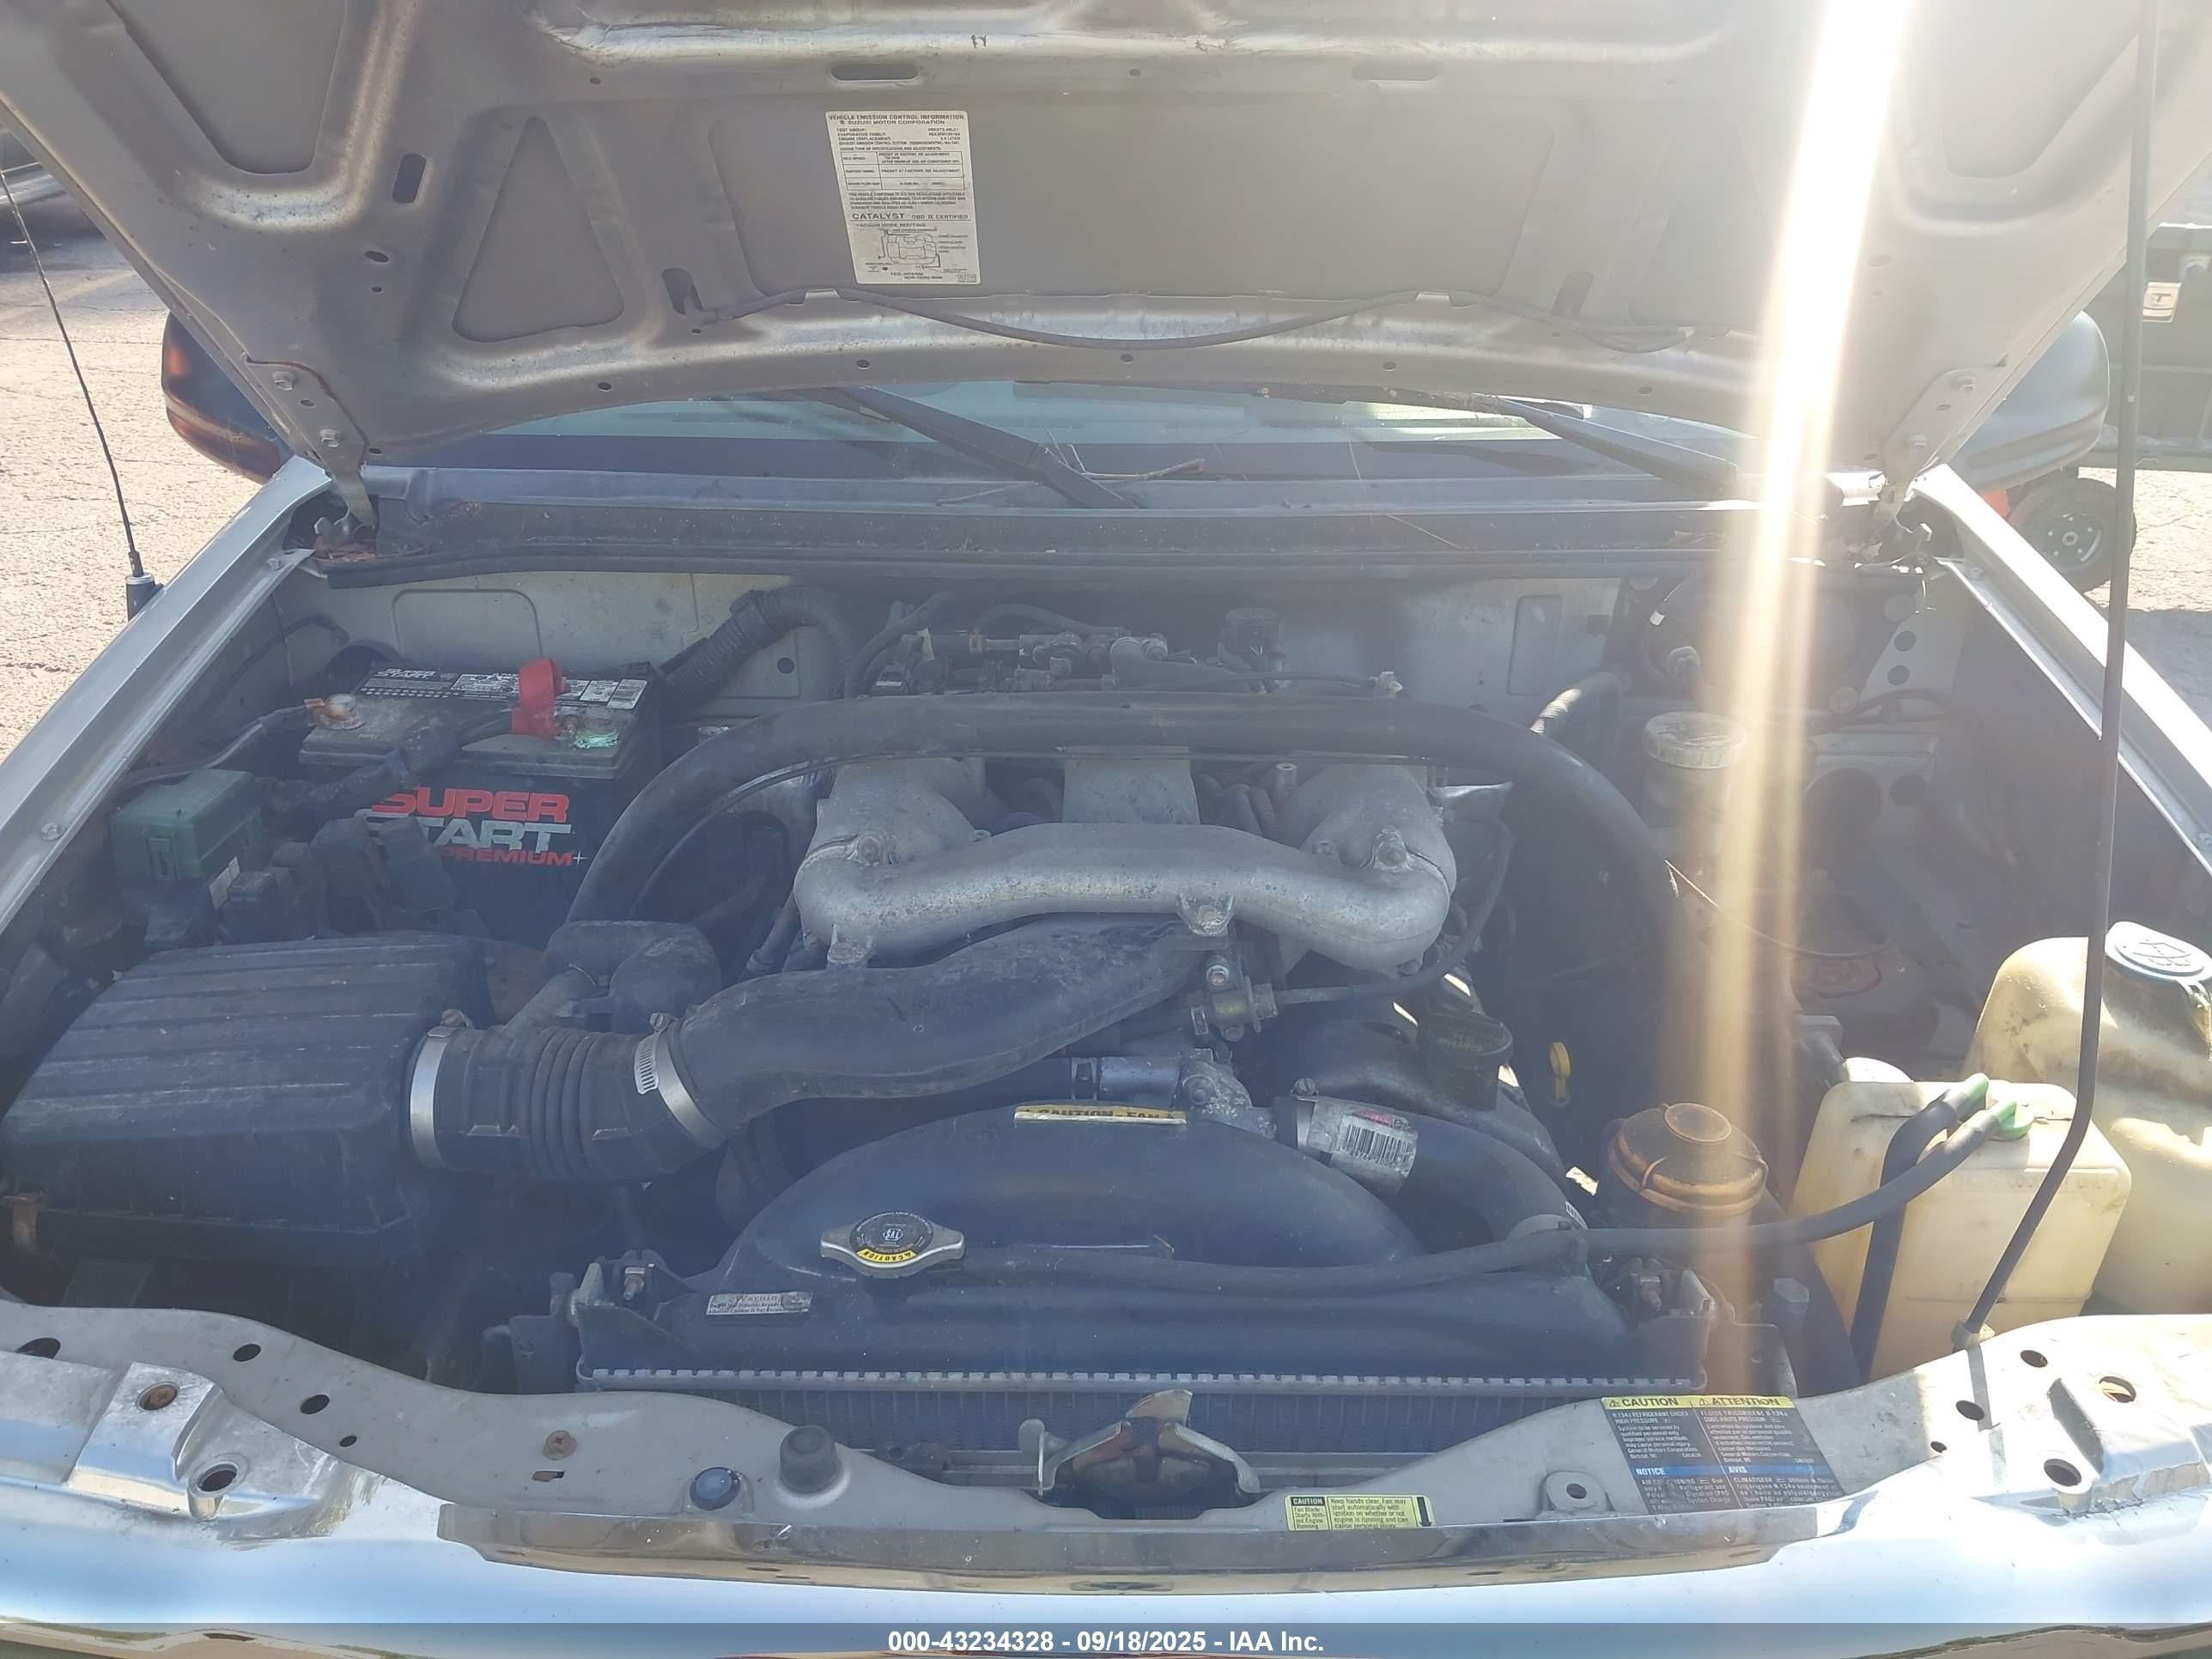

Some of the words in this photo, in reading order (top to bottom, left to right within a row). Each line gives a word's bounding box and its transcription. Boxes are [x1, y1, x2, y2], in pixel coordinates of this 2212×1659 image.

[371, 786, 570, 823] SUPER
[862, 1251, 904, 1261] CAUTION
[1622, 1398, 1680, 1407] CAUTION
[1712, 1397, 1780, 1407] ATTENTION
[1636, 1467, 1666, 1476] NOTICE
[1728, 1465, 1747, 1474] AVIS
